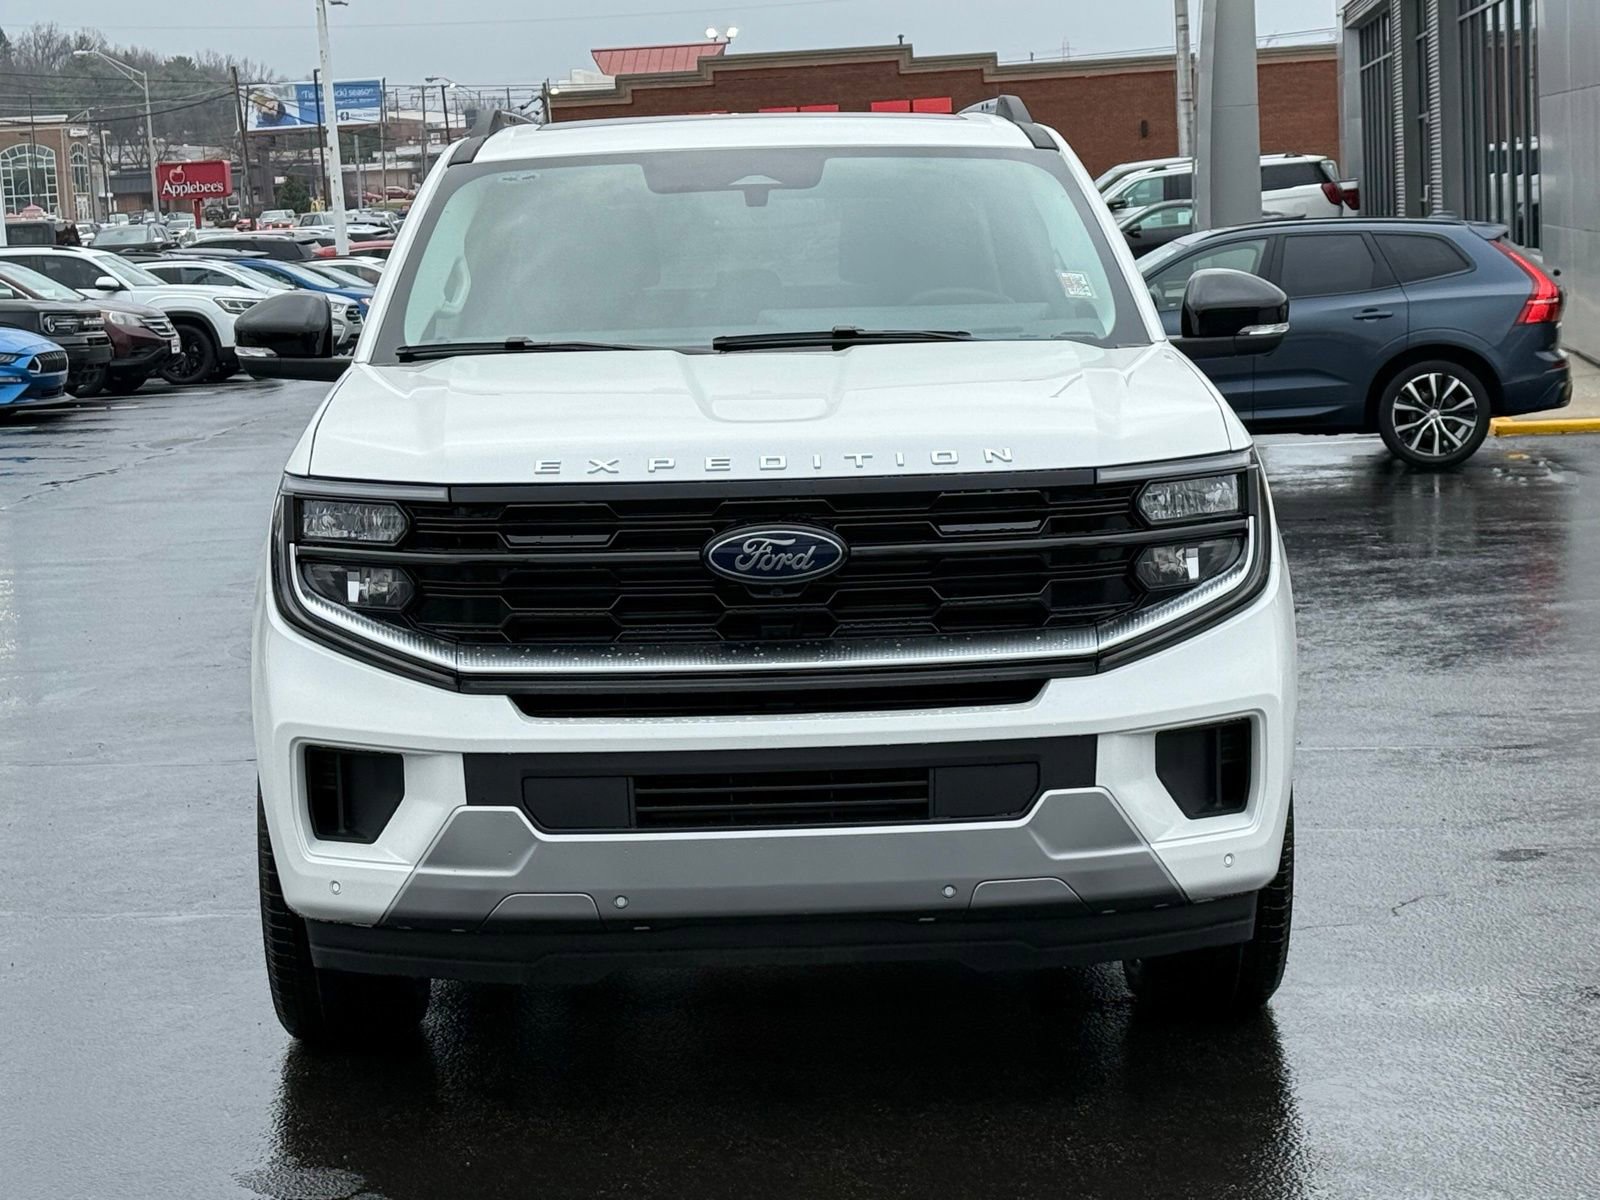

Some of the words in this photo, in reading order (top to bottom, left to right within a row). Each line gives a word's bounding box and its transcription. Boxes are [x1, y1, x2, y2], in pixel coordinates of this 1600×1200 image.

[162, 180, 224, 197] Applebee's
[534, 447, 1013, 475] EXPEDITION
[734, 537, 815, 571] Ford
